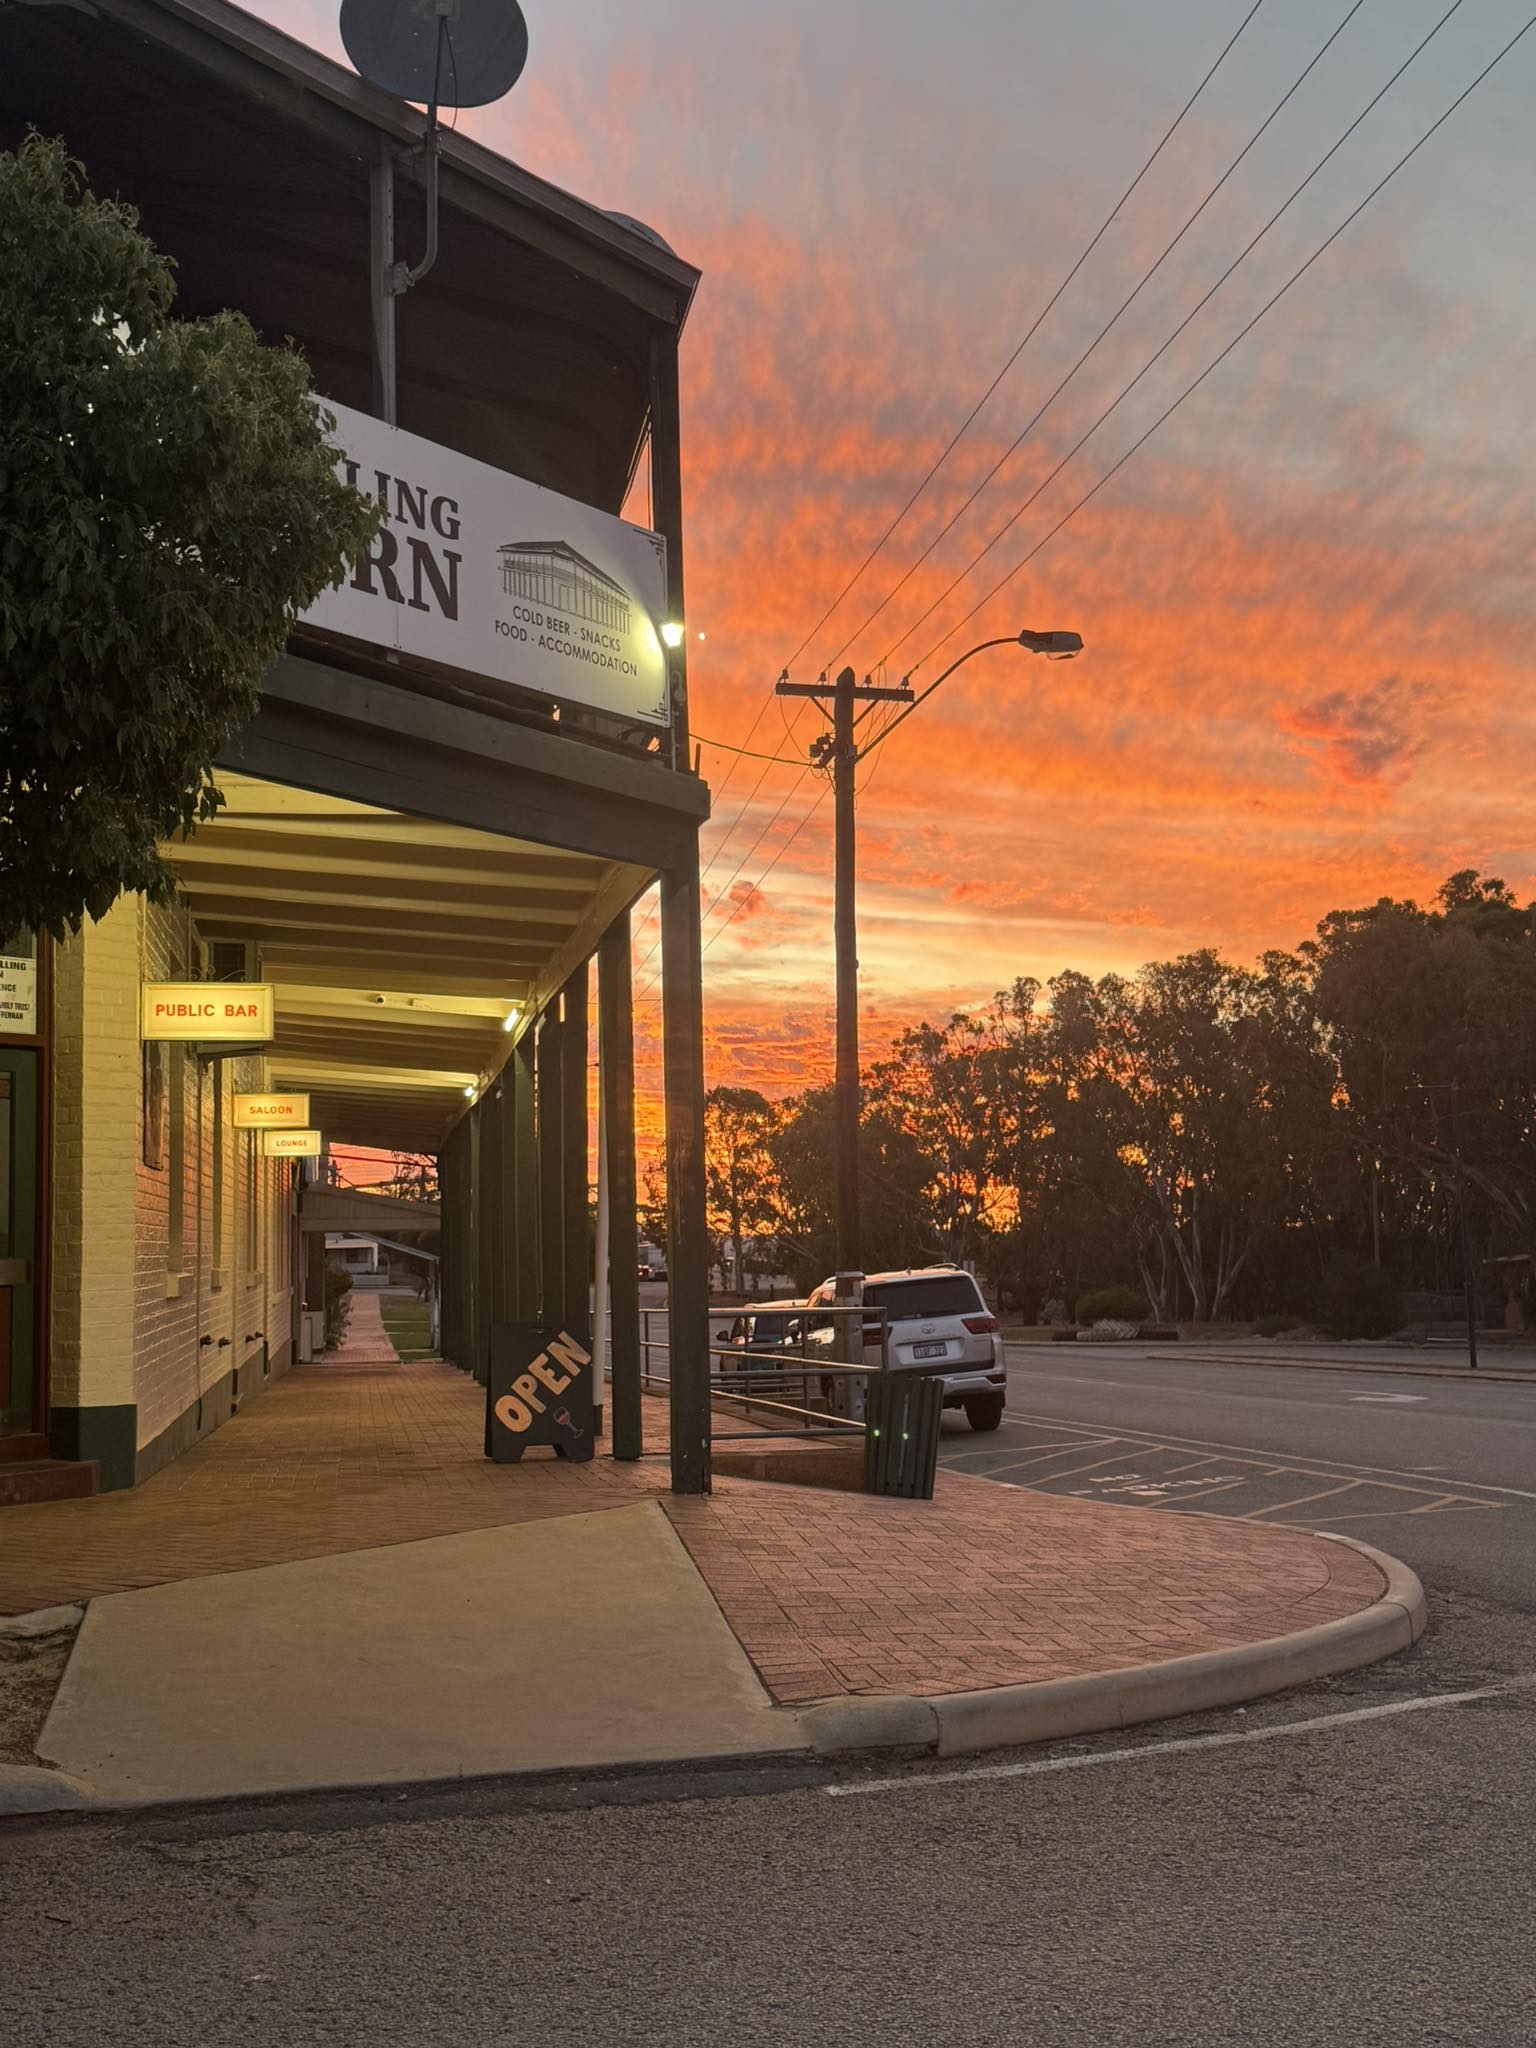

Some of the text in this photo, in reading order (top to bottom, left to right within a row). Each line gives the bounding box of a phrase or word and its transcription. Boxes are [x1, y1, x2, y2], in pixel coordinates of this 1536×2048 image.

[512, 605, 543, 627] COLD
[546, 616, 570, 636] BEER
[580, 627, 621, 652] SNACKS
[495, 619, 528, 642] FOOD
[538, 635, 637, 676] ACCOMMODATION
[155, 1004, 258, 1017] PUBLIC BAR
[249, 1105, 293, 1115] SALOON
[276, 1139, 308, 1148] LOUNGE
[494, 1330, 592, 1433] OPEN
